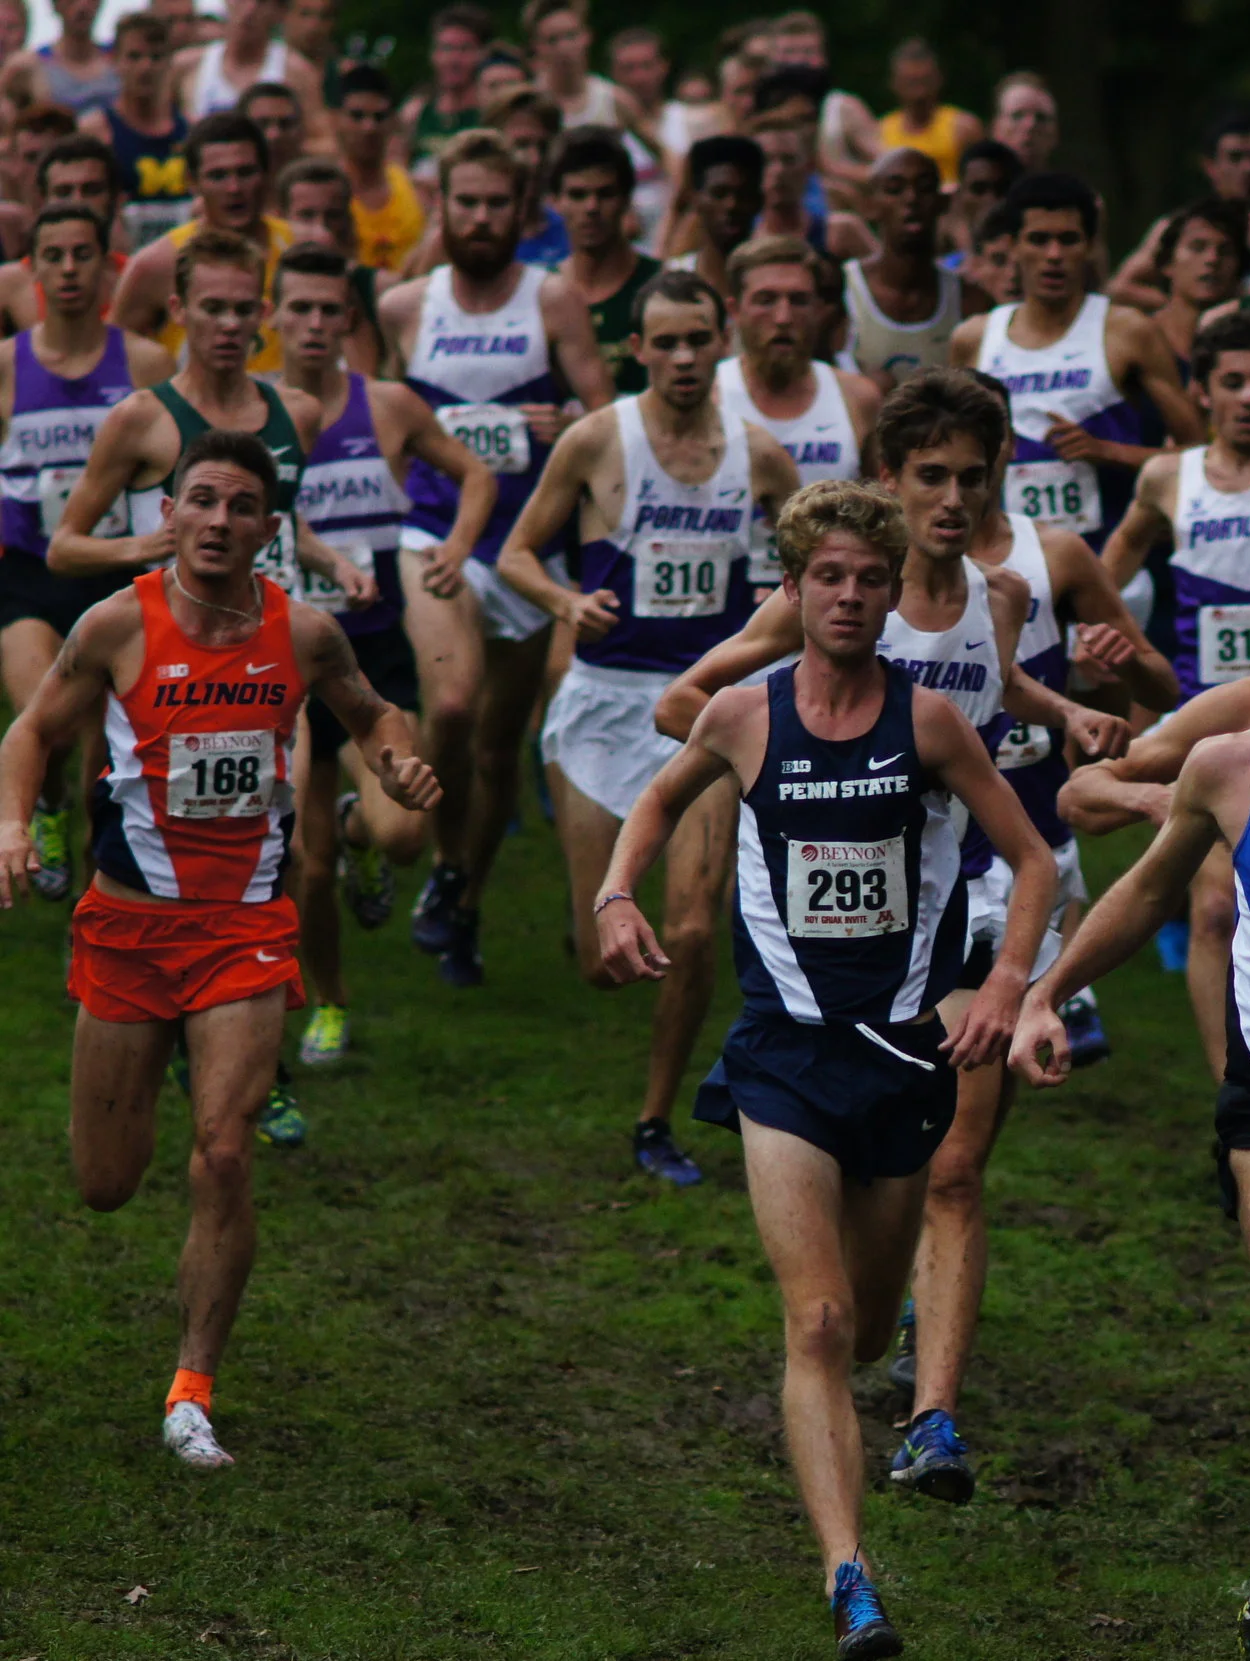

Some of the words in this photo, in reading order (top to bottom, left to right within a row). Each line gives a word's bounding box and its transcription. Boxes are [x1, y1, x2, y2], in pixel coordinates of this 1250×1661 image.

[1002, 369, 1092, 393] ORTLAND
[19, 424, 94, 451] FURM
[784, 442, 842, 464] LAND
[302, 477, 381, 505] RMAN
[1022, 482, 1081, 517] 316
[635, 506, 743, 533] PORTLAND
[655, 561, 714, 596] 310
[893, 658, 987, 692] RTLAND
[153, 683, 287, 708] ILLINOIS
[192, 756, 259, 795] 168
[779, 781, 838, 800] PENN
[840, 775, 909, 798] STATE
[821, 845, 886, 860] BEYNON
[808, 869, 887, 912] 293
